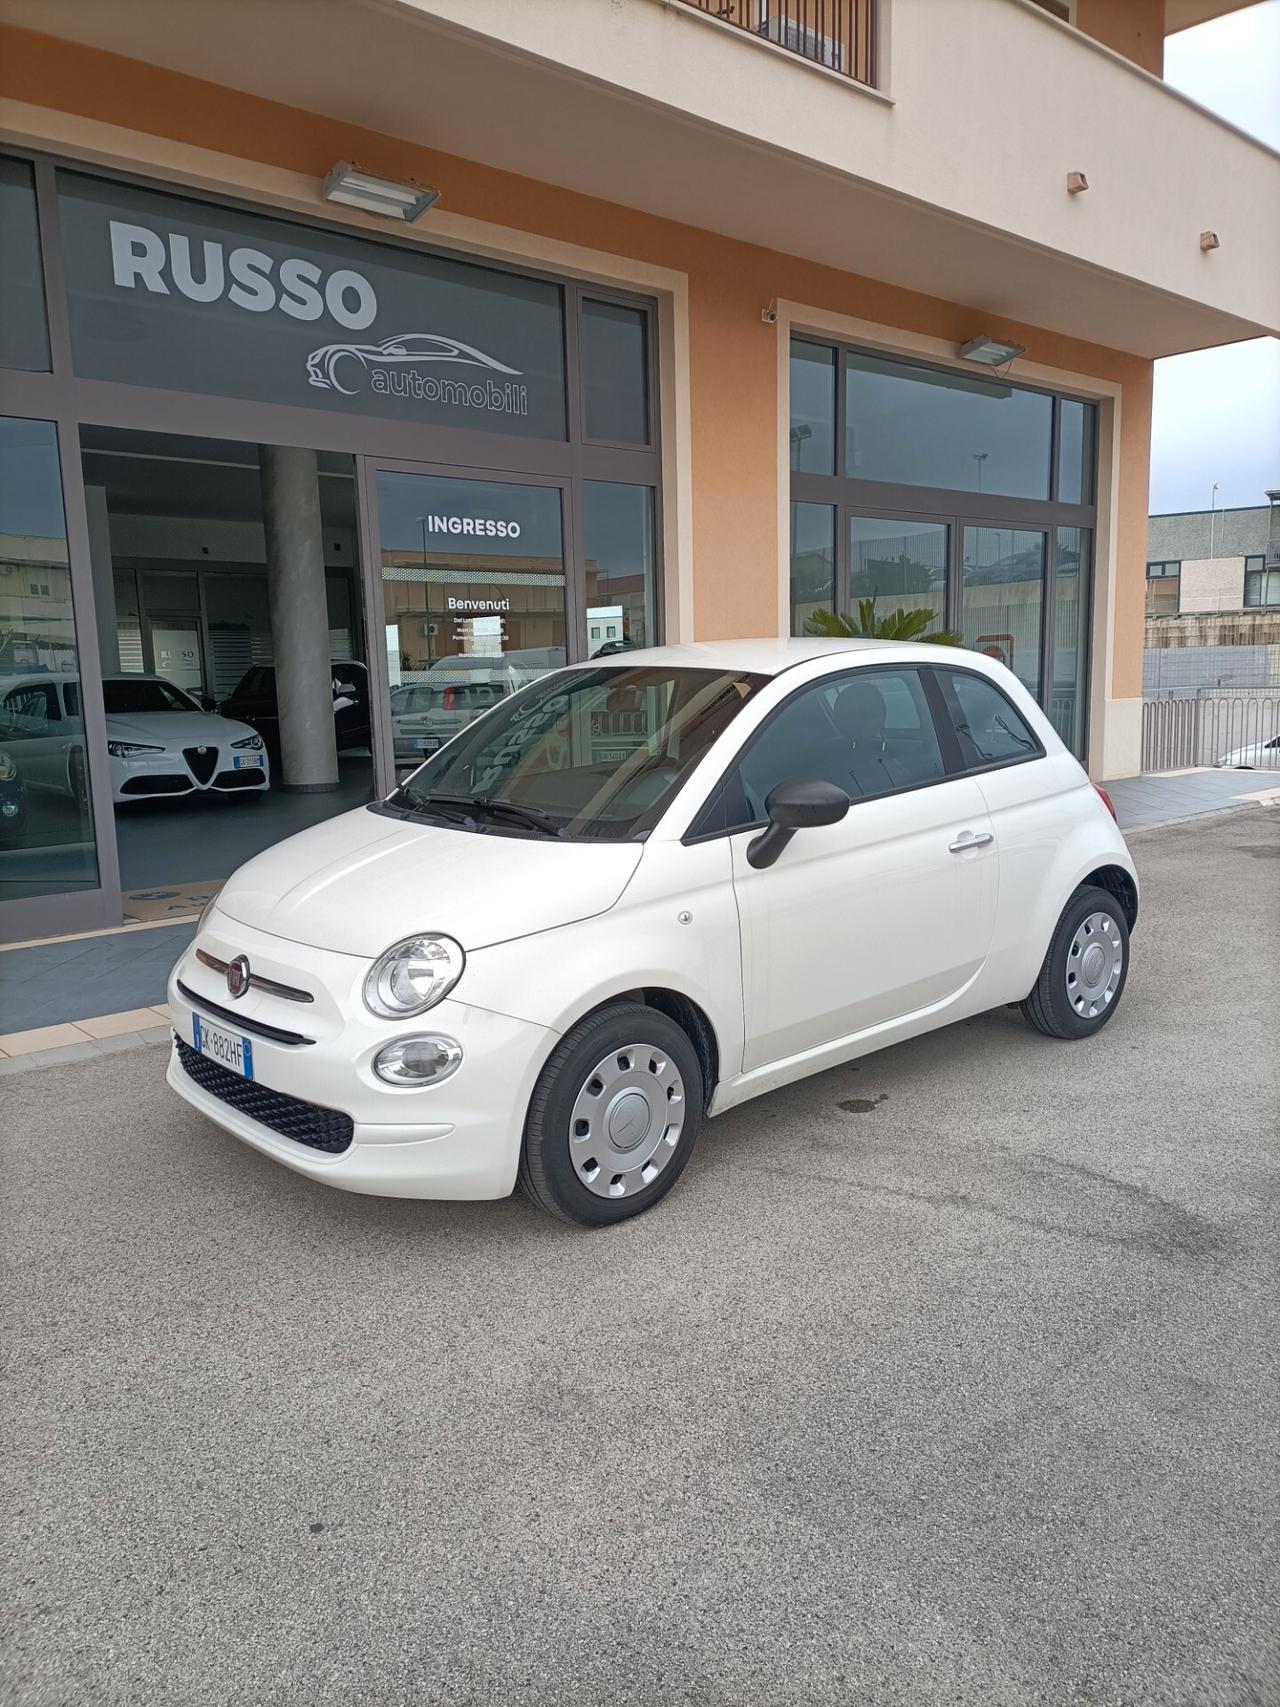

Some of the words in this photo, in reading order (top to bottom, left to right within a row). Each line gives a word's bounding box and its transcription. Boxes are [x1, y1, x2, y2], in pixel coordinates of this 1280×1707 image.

[109, 220, 377, 330] RUSSO
[371, 368, 527, 415] automobili
[428, 515, 521, 538] INGRESSO
[447, 597, 510, 610] Benvenuti
